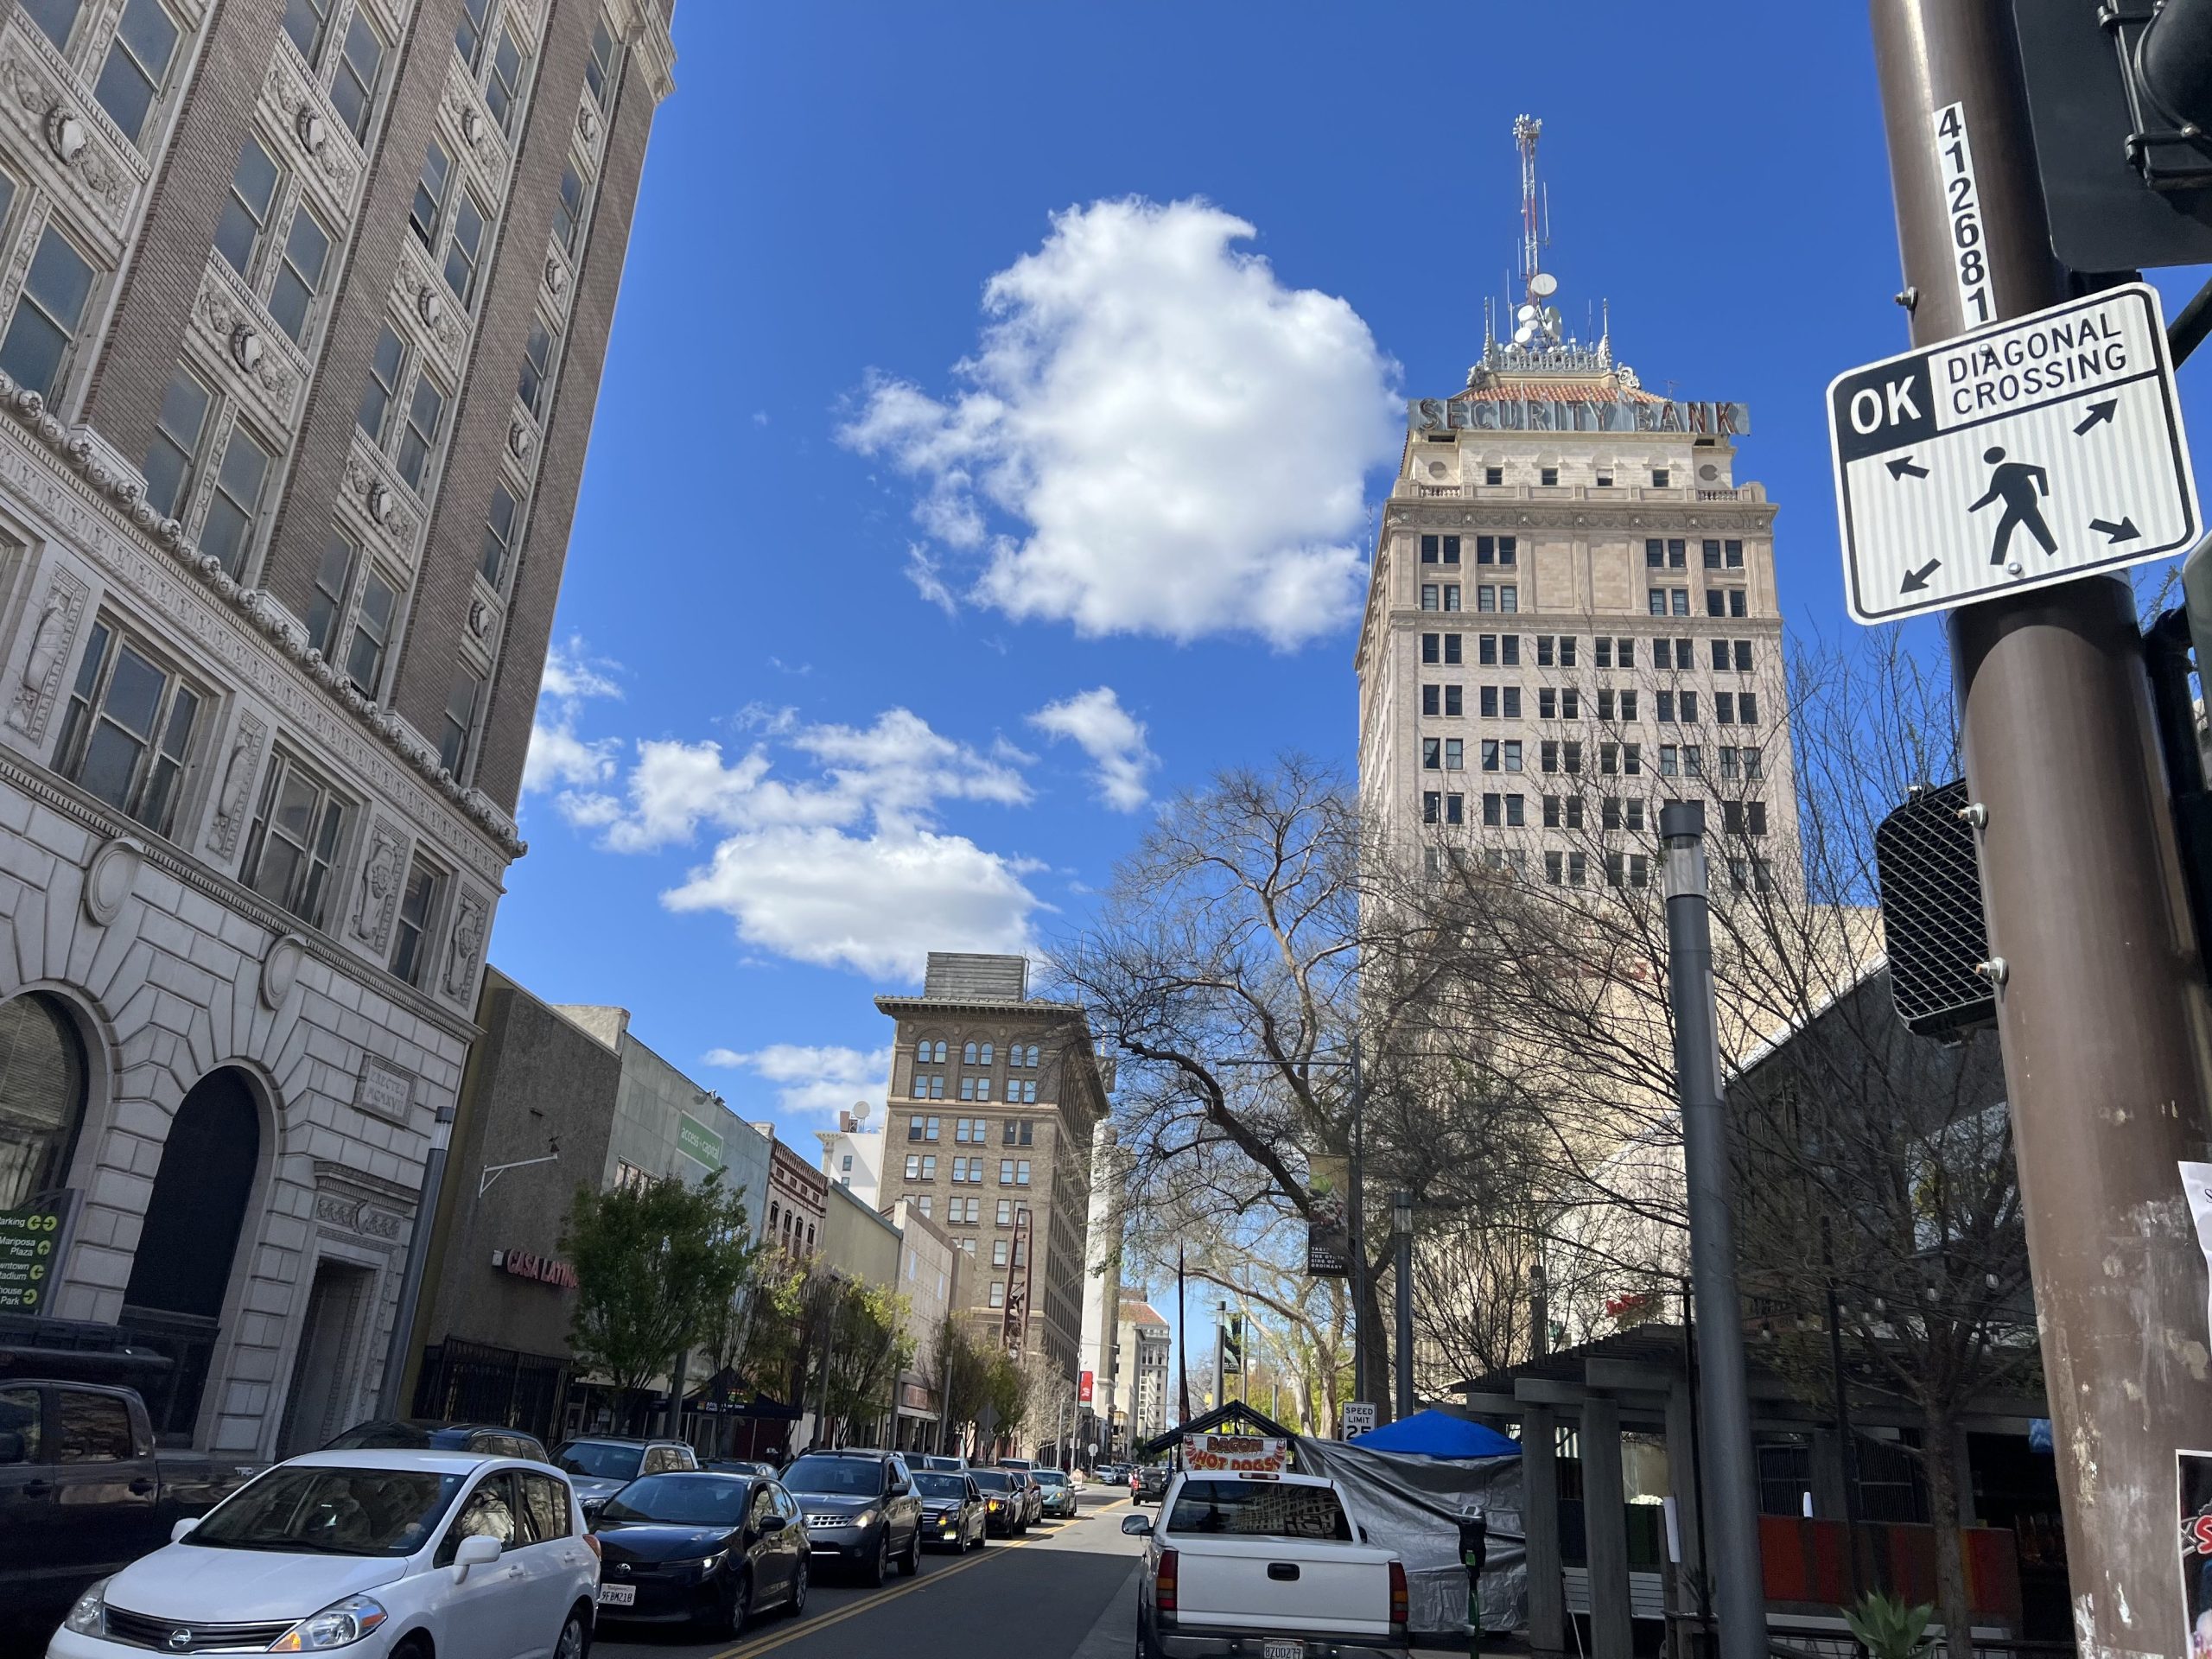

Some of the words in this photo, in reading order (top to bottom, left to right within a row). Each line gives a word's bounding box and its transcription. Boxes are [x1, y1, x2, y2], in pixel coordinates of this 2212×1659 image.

[1937, 107, 1990, 322] 412681
[1947, 311, 2123, 384] DIAGONAL
[1953, 341, 2127, 416] CROSSING
[1849, 374, 1923, 435] OK
[1419, 397, 1611, 432] SECURITY
[1630, 401, 1740, 435] BANK
[0, 1217, 25, 1228] arking
[10, 1247, 33, 1256] Plaza
[507, 1249, 539, 1279] CASA
[0, 1271, 27, 1280] tadium
[0, 1286, 22, 1295] house
[1, 1296, 19, 1306] Park
[1345, 1407, 1373, 1415] SPEED
[1348, 1415, 1370, 1424] LIMIT
[1206, 1436, 1263, 1453] BACON
[1195, 1450, 1228, 1470] HOT
[1230, 1457, 1273, 1471] DOGS
